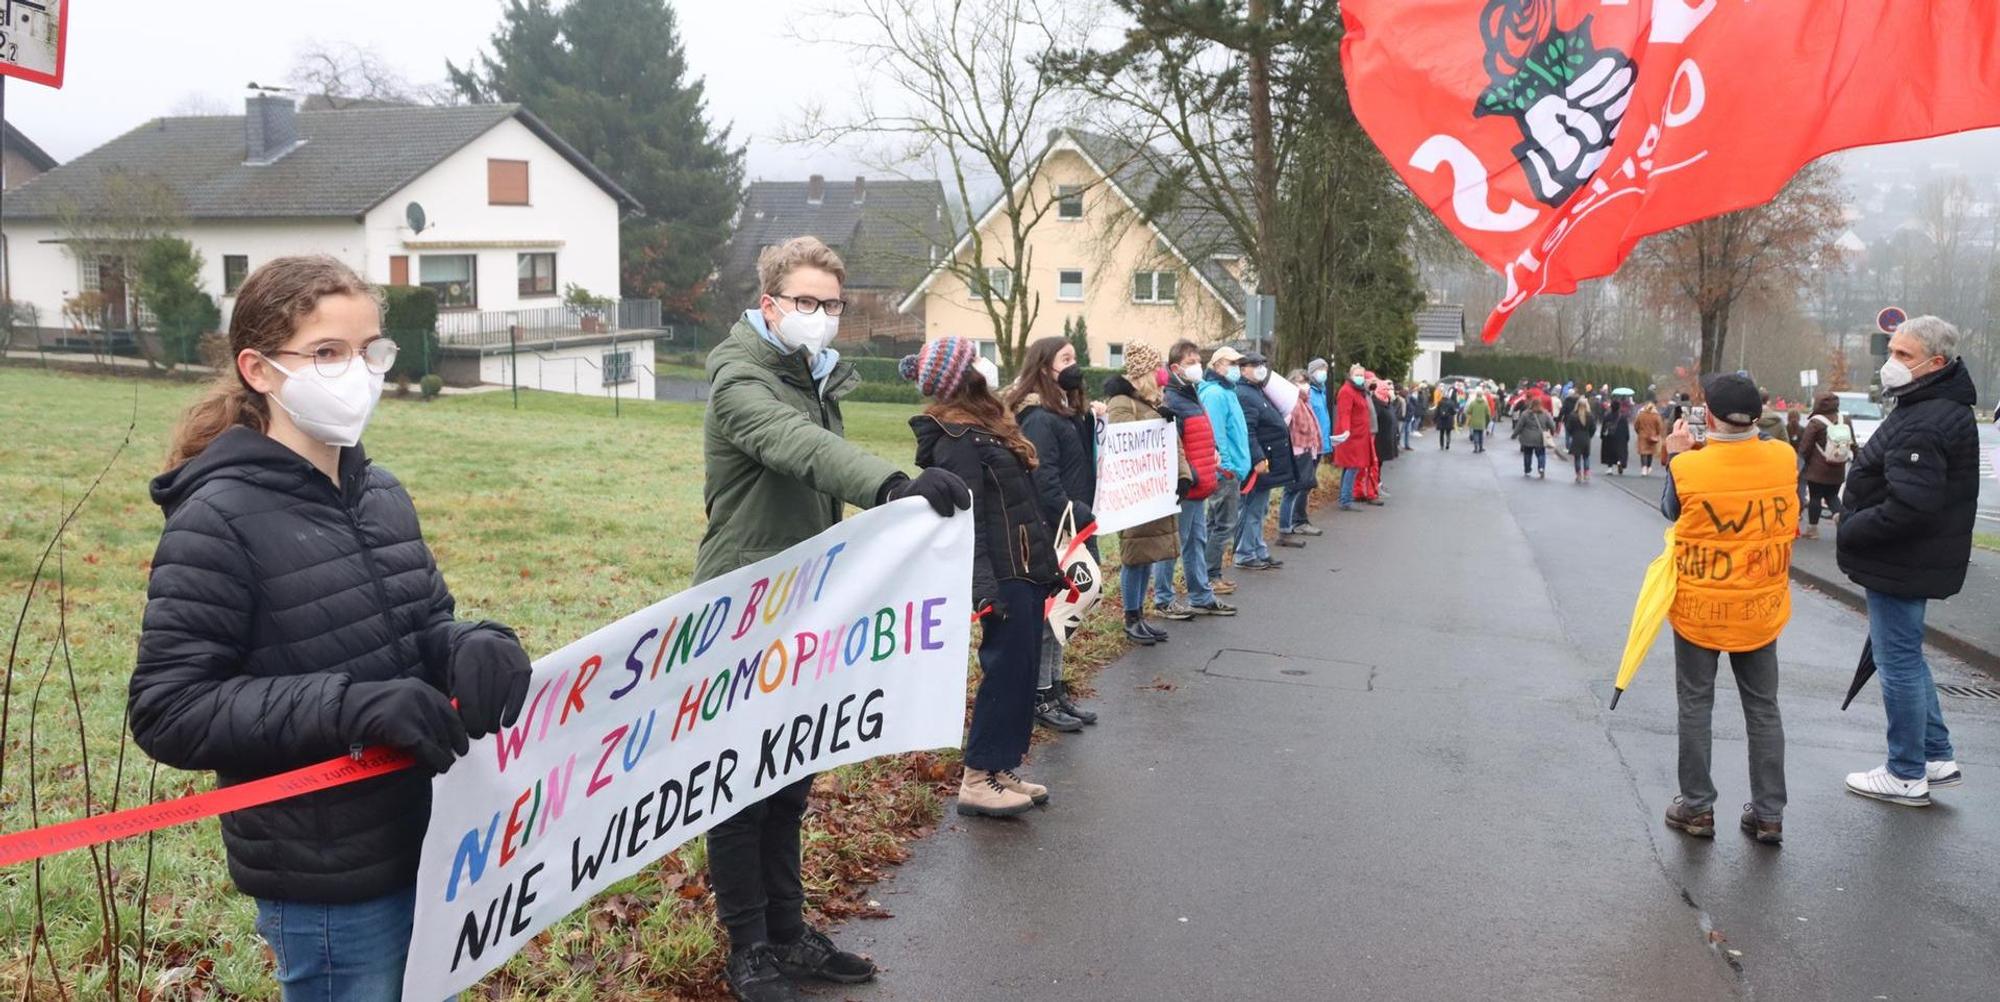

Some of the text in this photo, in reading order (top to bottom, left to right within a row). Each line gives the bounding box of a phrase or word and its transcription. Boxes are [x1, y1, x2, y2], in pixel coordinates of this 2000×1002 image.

[1107, 427, 1167, 454] ALTERNATIVE
[1702, 496, 1789, 535] WIR
[495, 542, 846, 773] WIR SIND BUNT
[322, 764, 356, 782] zum
[445, 597, 948, 902] NEIN ZU HOMOPHOBIE
[450, 688, 884, 973] NIE WIEDER KRIEG
